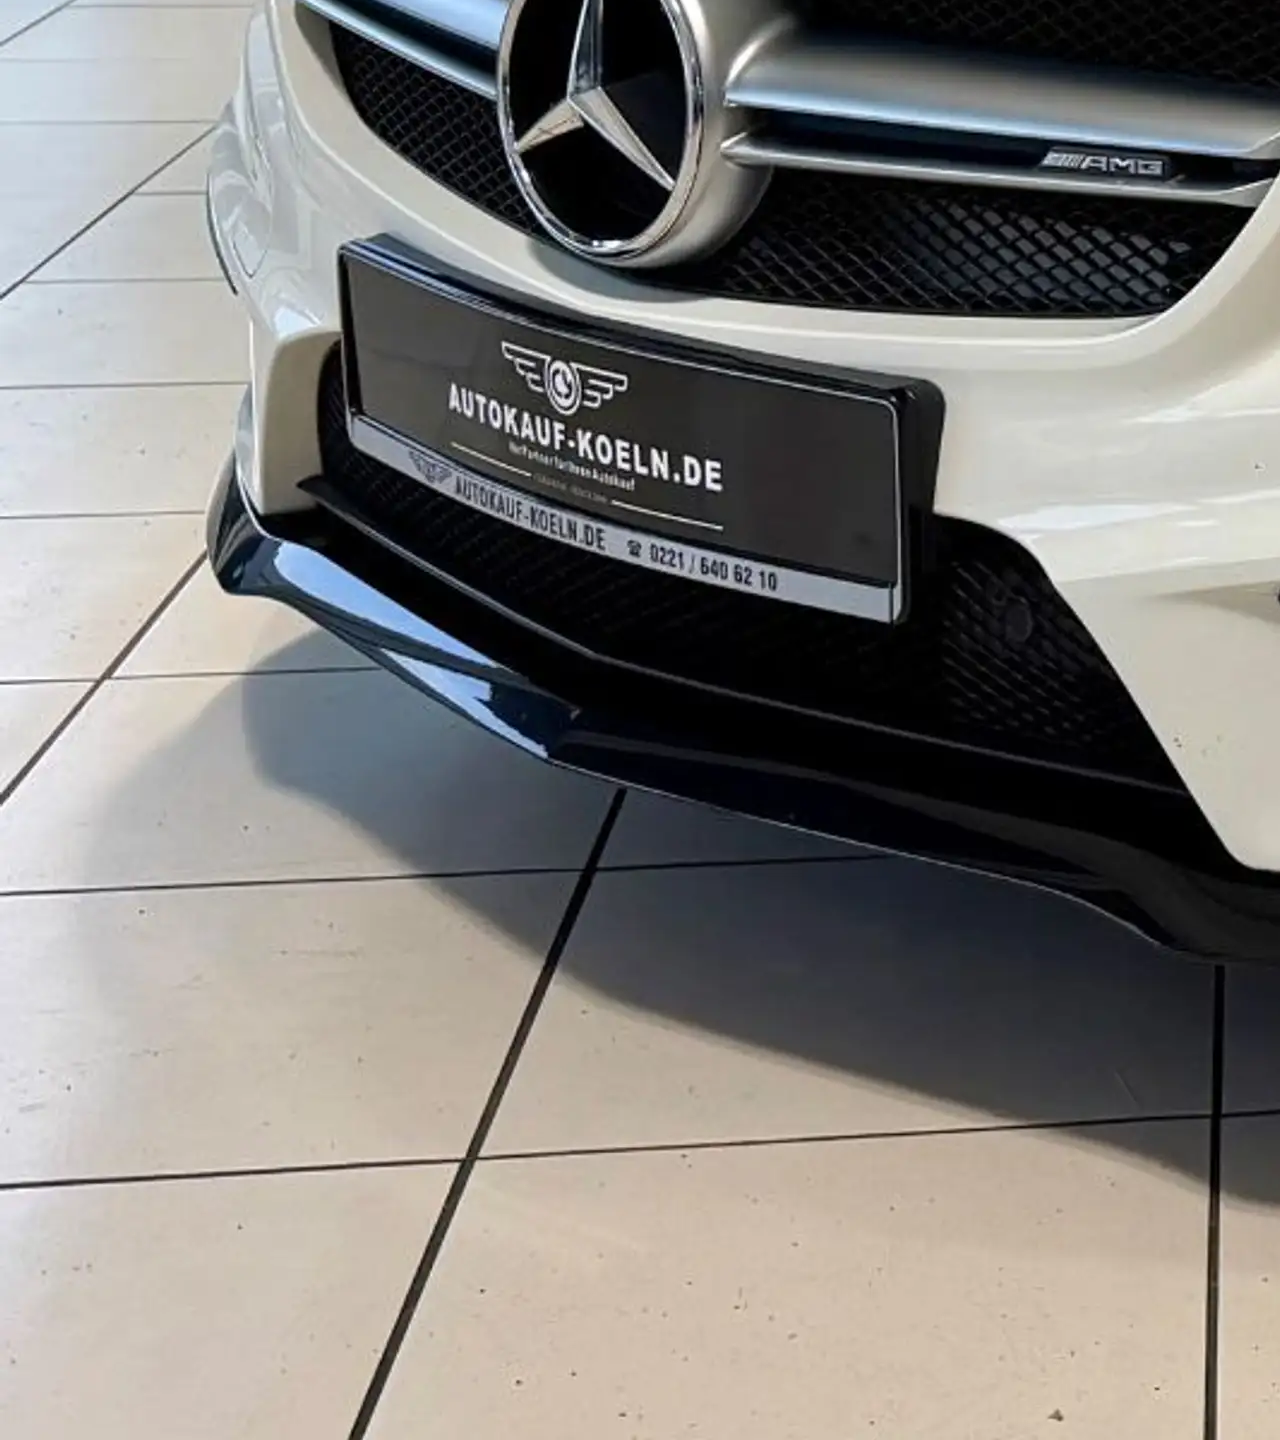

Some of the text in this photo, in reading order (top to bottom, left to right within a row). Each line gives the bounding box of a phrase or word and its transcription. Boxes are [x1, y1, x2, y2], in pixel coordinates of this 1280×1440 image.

[448, 382, 723, 492] AUTOKAUF-KOELN.DE
[454, 474, 606, 551] AUTOKAUF-KOELN.DE
[650, 542, 685, 571] 0221
[700, 557, 729, 581] 640
[734, 563, 753, 587] 62
[758, 569, 778, 592] 10
